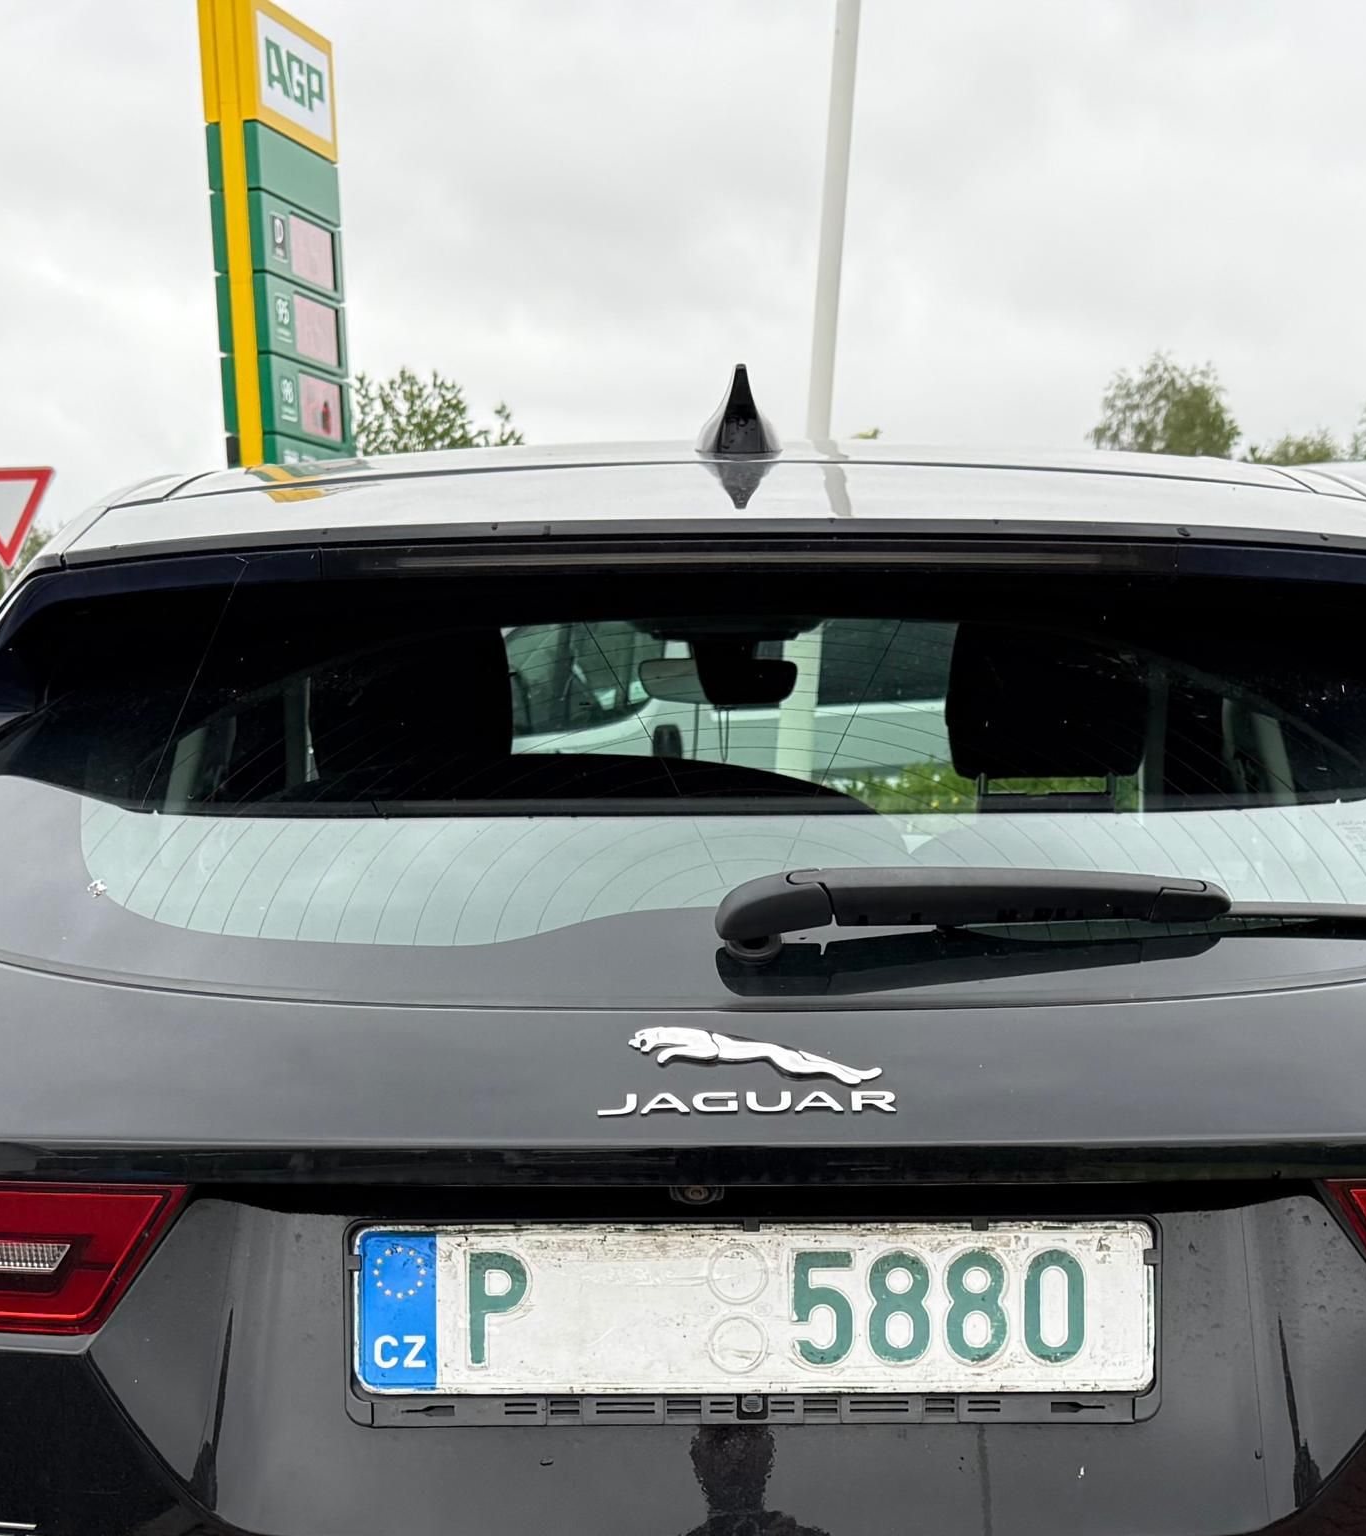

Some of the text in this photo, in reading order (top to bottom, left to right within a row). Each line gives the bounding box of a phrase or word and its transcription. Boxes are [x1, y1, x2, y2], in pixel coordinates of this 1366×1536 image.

[265, 36, 325, 113] AGP
[597, 1090, 898, 1117] JAGUAR
[467, 1249, 1086, 1367] P 5880
[373, 1335, 427, 1369] CZ
